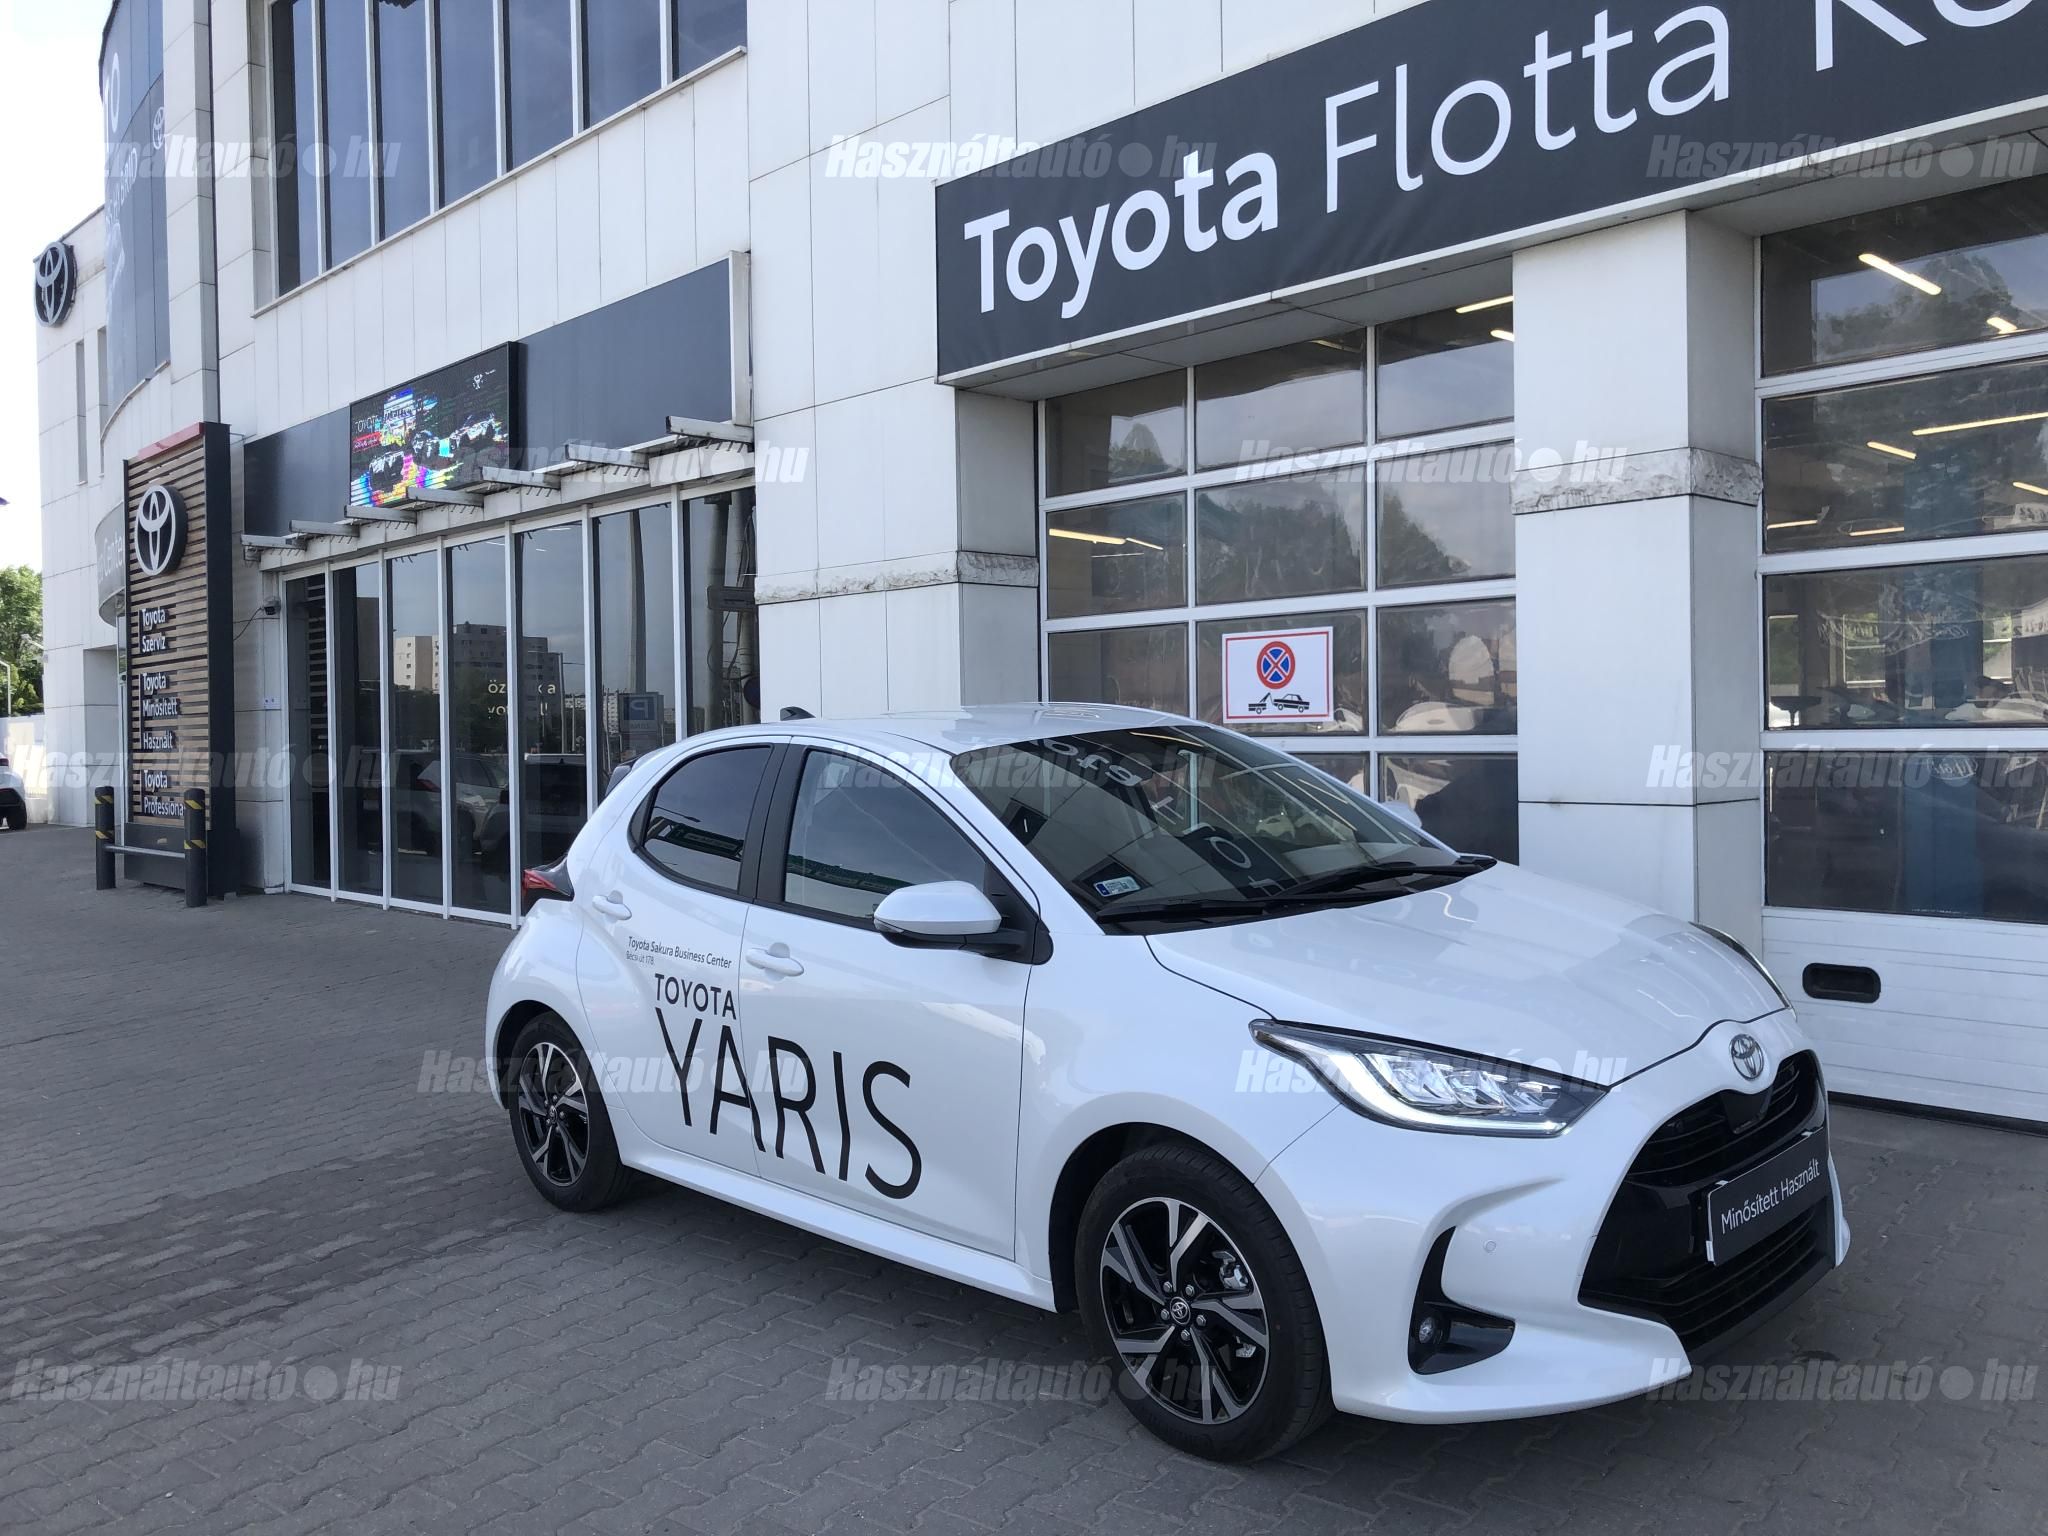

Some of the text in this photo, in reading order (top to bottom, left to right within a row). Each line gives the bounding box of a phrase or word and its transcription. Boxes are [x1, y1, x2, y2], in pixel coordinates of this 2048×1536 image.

[964, 152, 1279, 319] Toyota
[1324, 4, 1730, 213] Flotta
[141, 606, 166, 631] Toyota
[142, 633, 166, 653] Szerviz
[143, 672, 167, 695] Toyota
[143, 730, 173, 750] Használt
[143, 769, 168, 792] Toyota
[143, 797, 186, 816] Professiona
[628, 936, 732, 968] Toyota Sakura Business Center
[655, 973, 736, 1020] TOYOTA
[655, 1007, 922, 1199] YARIS
[1721, 1158, 1820, 1235] Minősített Használt
